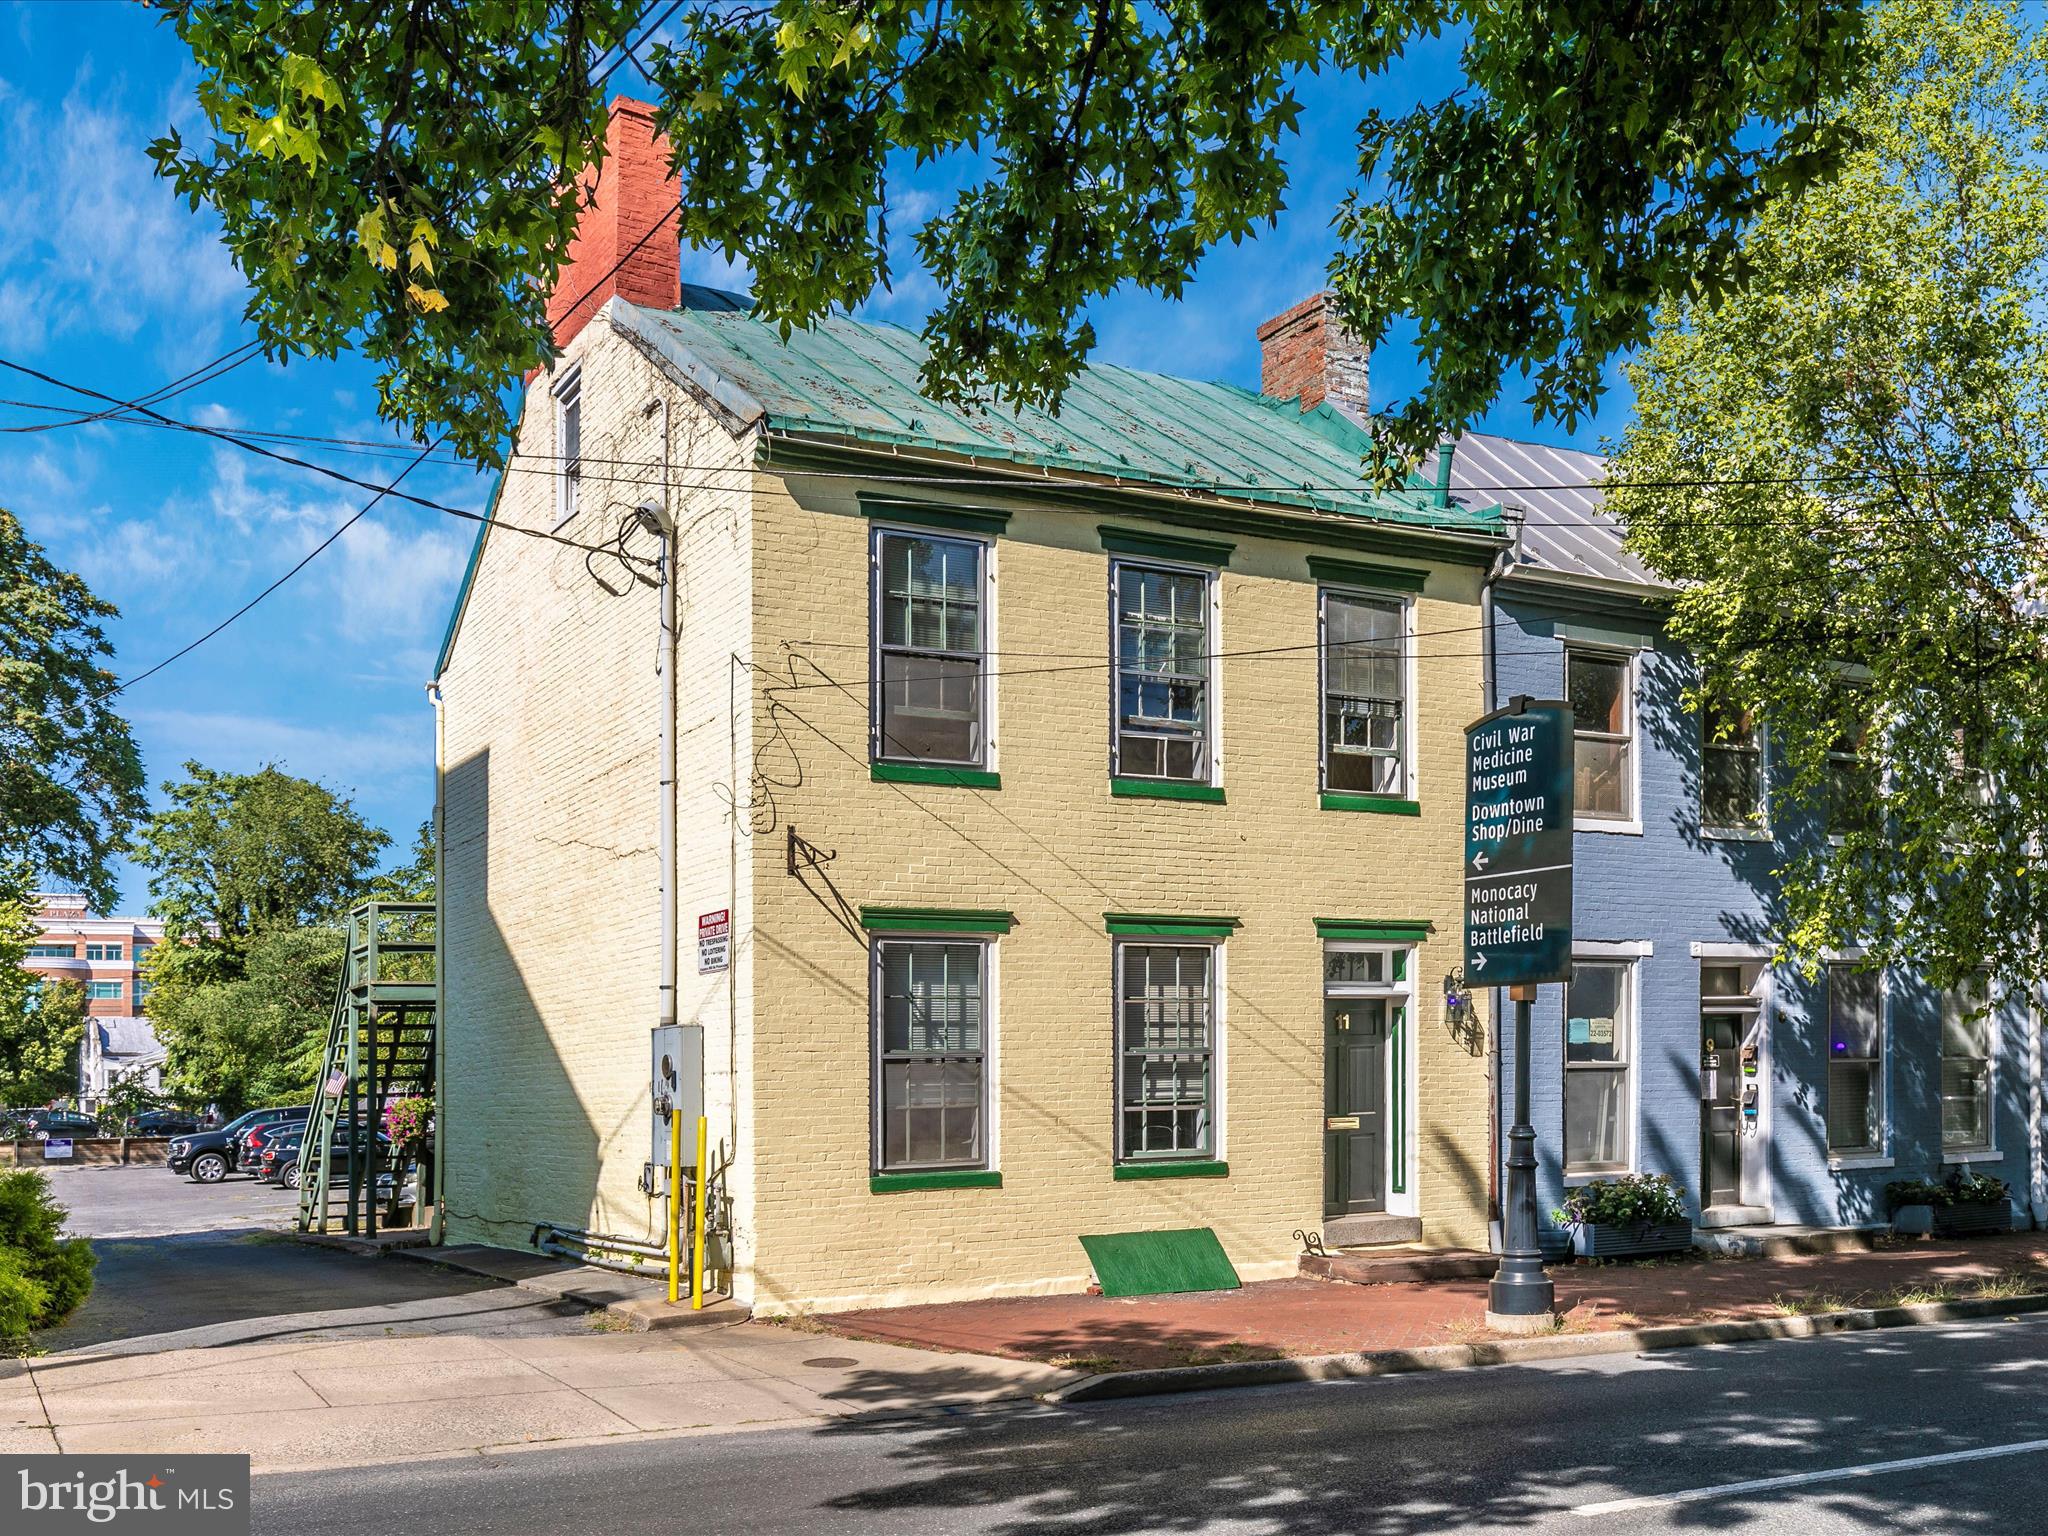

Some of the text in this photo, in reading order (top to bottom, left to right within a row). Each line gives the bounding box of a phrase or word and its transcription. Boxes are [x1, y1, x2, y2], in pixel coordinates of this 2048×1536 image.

[1473, 726, 1535, 751] Civil War
[1473, 747, 1533, 772] Medicine
[1472, 769, 1527, 792] Museum
[1472, 796, 1544, 822] Downtown
[1472, 816, 1543, 842] Shop/Dine
[1471, 883, 1537, 904] Monocacy
[1471, 902, 1529, 926] National
[699, 922, 728, 938] PRIVATE DRIVE
[699, 935, 728, 947] NO TRESPASSING
[1471, 922, 1543, 947] Battlefield
[702, 945, 726, 956] NO LOITERING
[704, 957, 710, 965] NO
[1336, 1014, 1350, 1030] 11
[1706, 1038, 1714, 1052] 9
